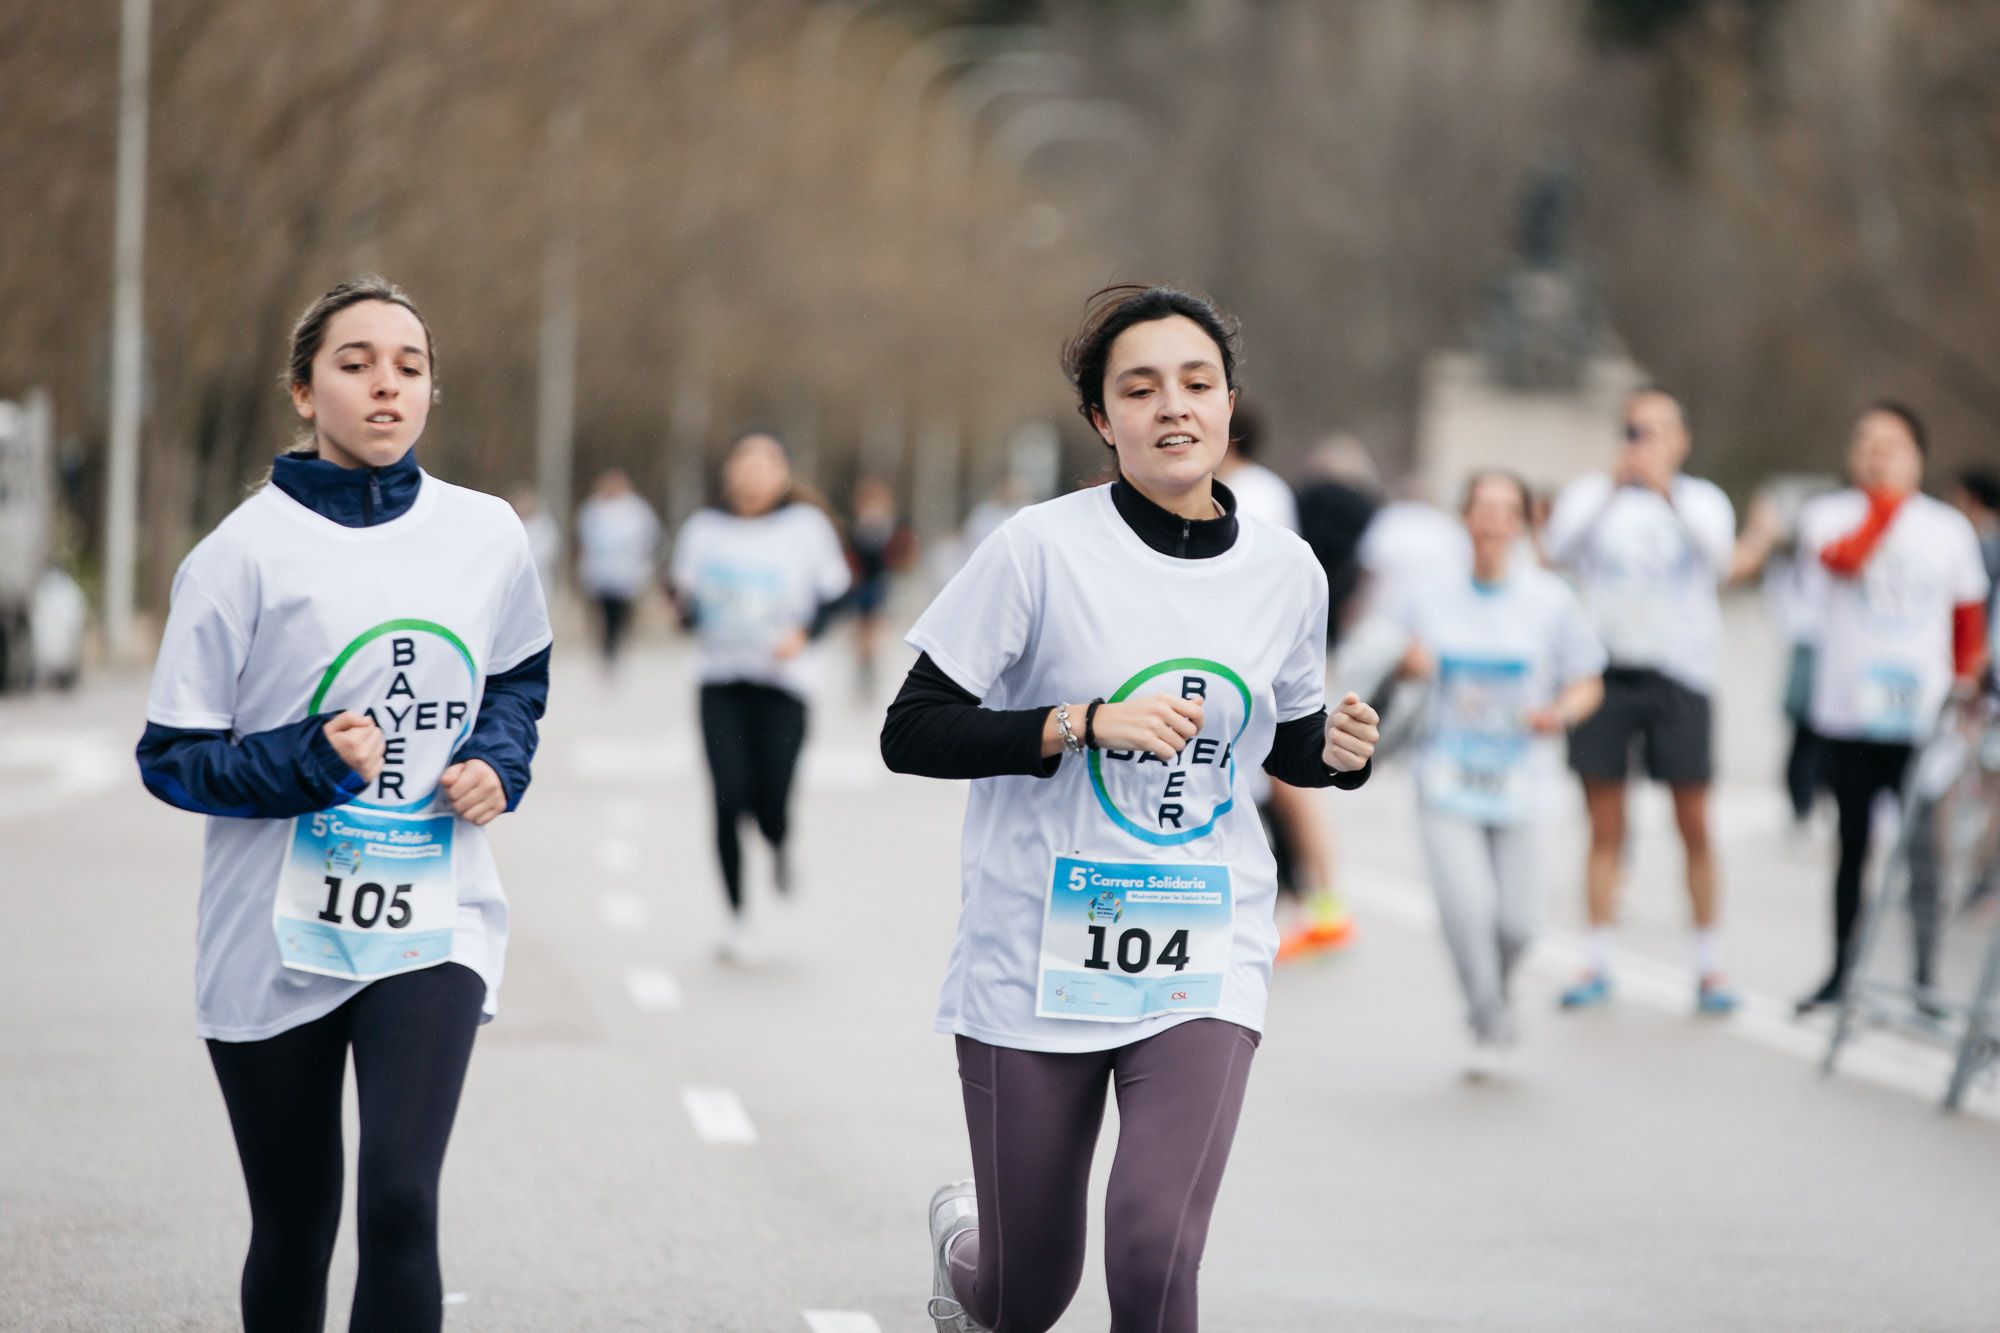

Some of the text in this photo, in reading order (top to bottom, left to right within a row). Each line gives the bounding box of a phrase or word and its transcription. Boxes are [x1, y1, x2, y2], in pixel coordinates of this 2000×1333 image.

[363, 701, 467, 733] AYER
[1091, 873, 1144, 889] Carrera
[1147, 875, 1206, 890] Solidaria
[319, 875, 413, 929] 105
[1084, 925, 1190, 973] 104
